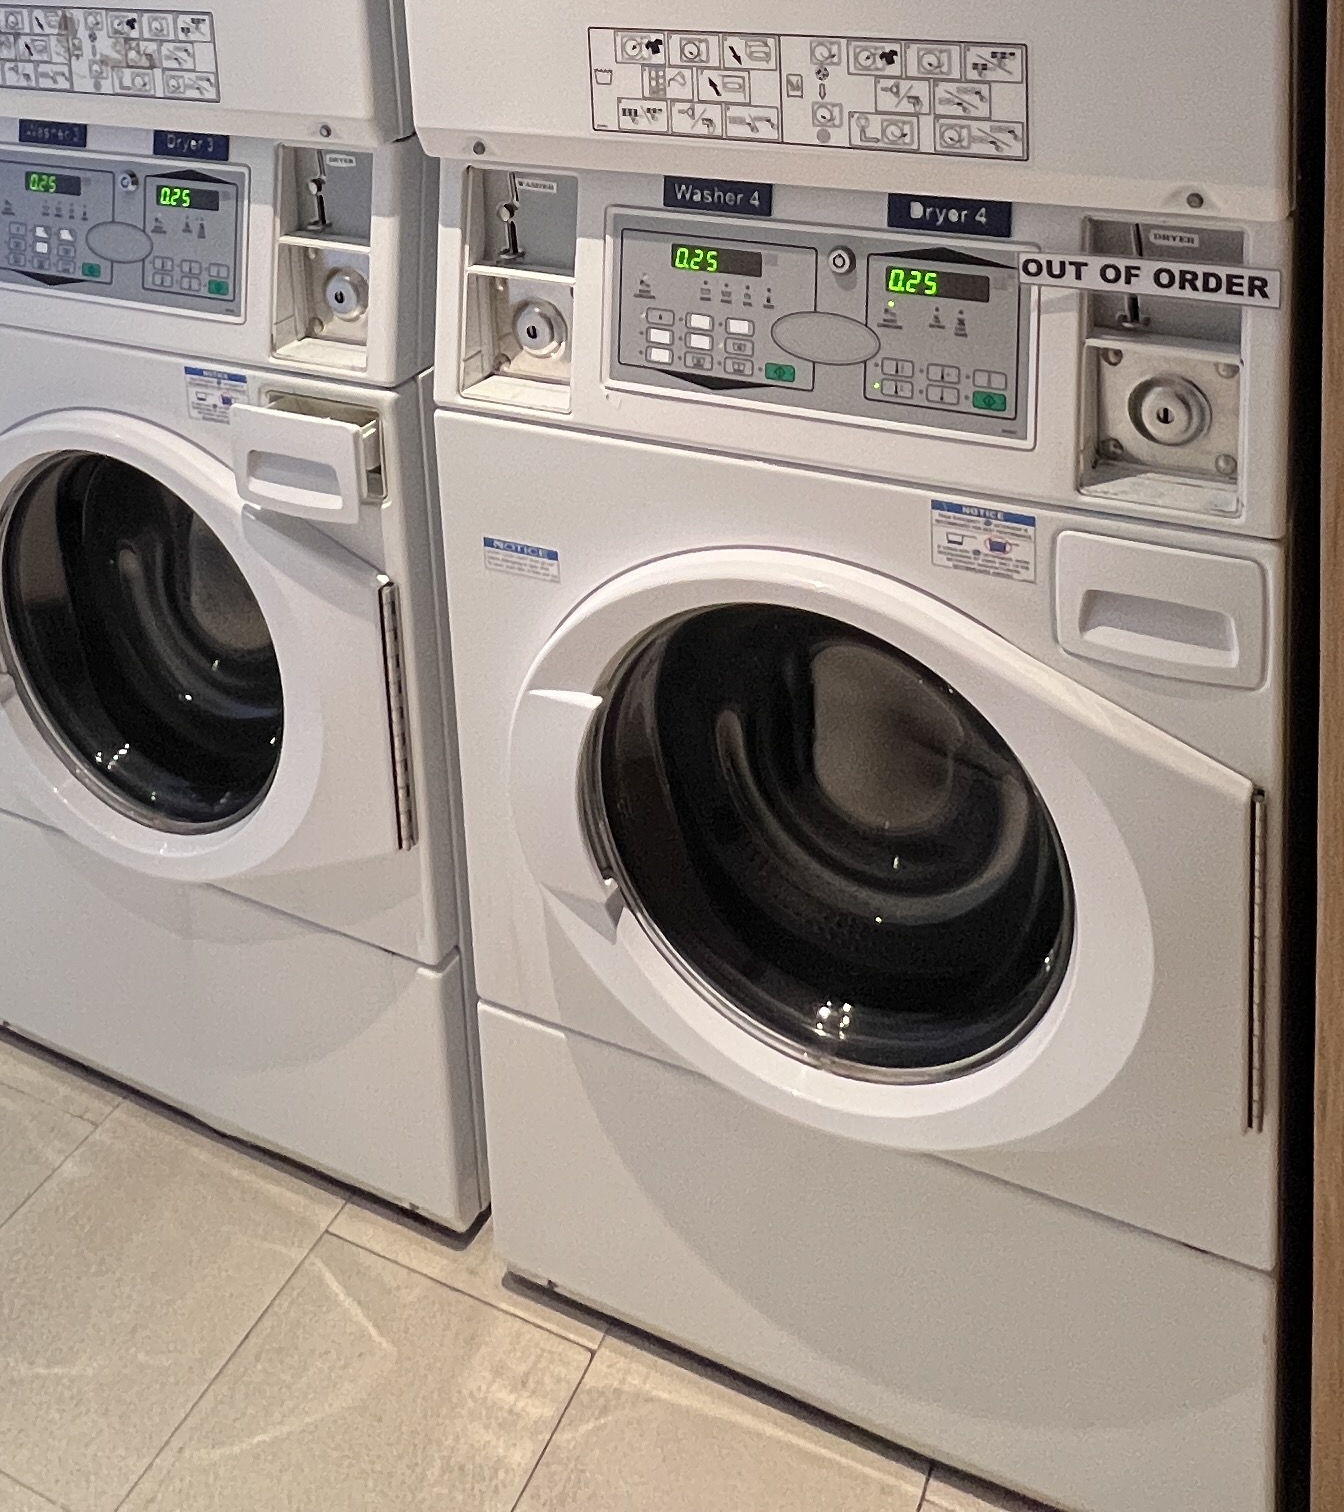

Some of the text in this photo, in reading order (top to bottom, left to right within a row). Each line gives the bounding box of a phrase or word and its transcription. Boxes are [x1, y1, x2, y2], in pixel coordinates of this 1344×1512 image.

[166, 133, 203, 153] Dryer
[674, 183, 760, 208] Washer 4
[909, 200, 987, 226] Dryer 4
[1153, 232, 1195, 245] DRYER
[1021, 257, 1271, 300] OUT OF ORDER
[961, 505, 1004, 520] NOTICE
